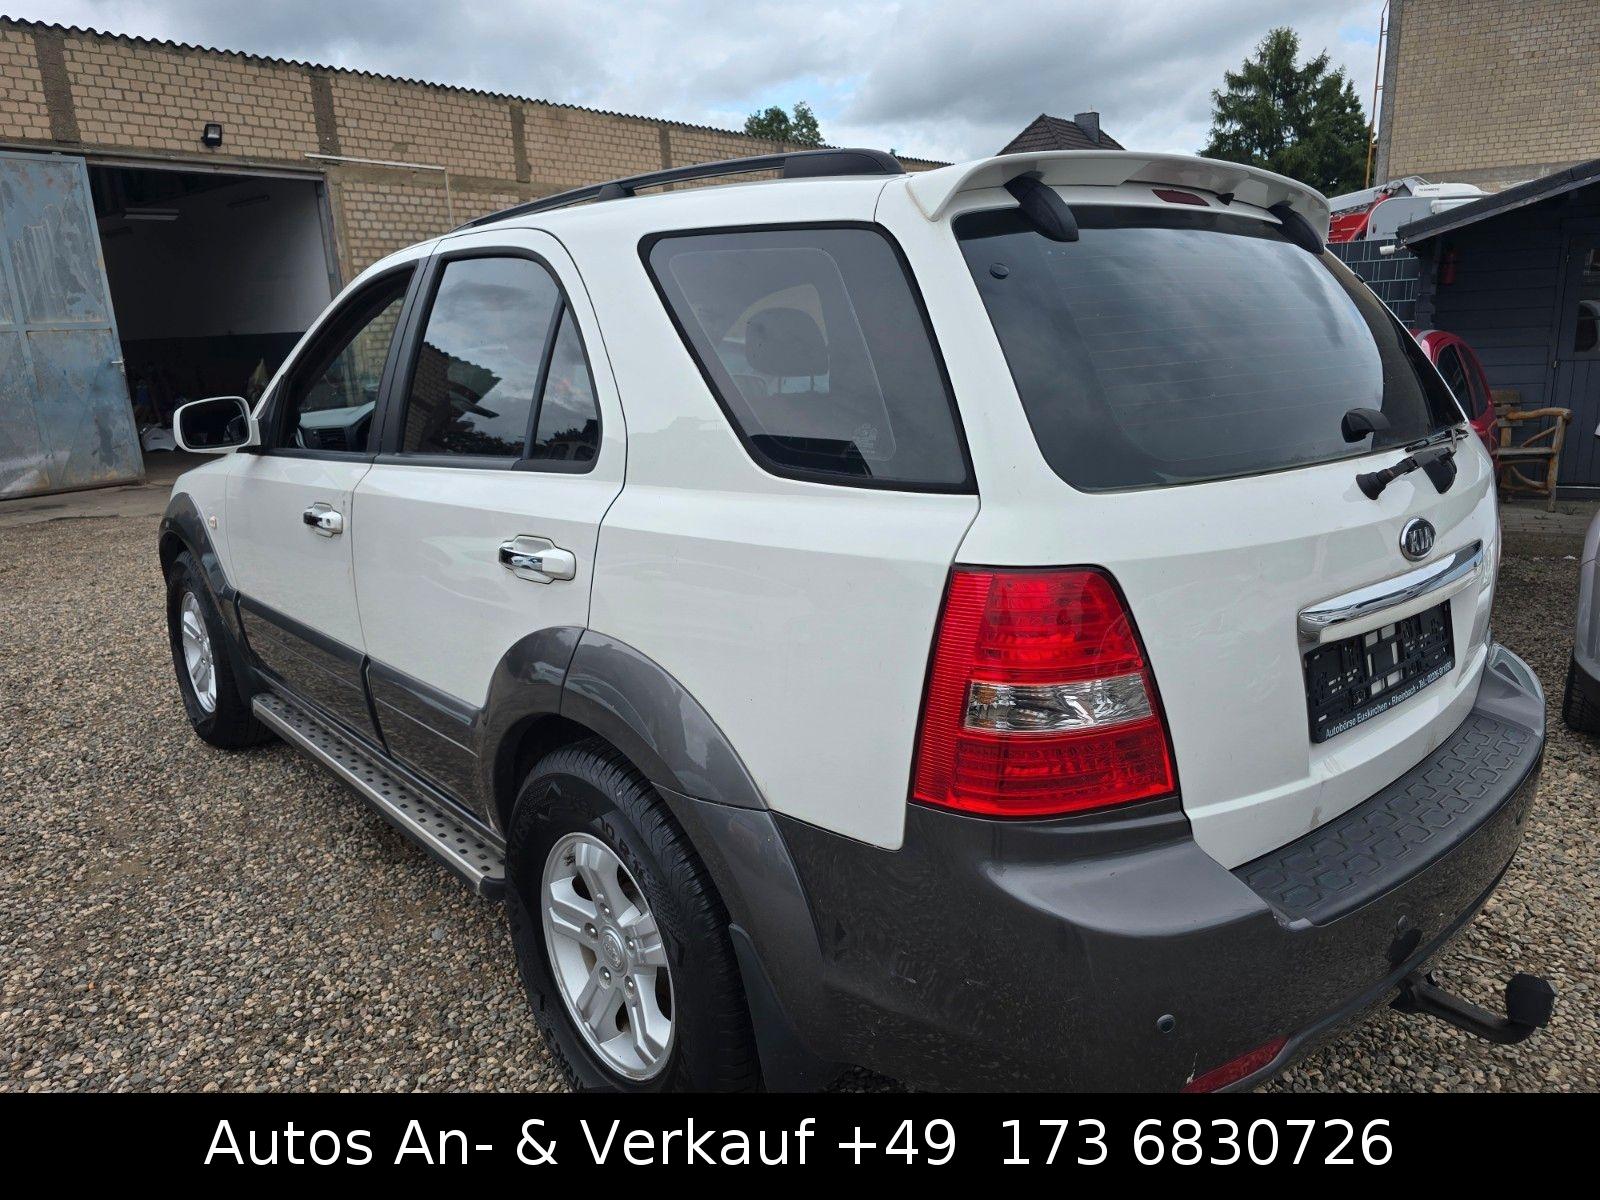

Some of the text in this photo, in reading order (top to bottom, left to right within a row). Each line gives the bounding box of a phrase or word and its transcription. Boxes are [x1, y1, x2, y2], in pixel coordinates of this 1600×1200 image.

[1408, 527, 1434, 553] KIA
[1325, 717, 1356, 739] Autobörse
[1356, 702, 1388, 723] Euskirchen
